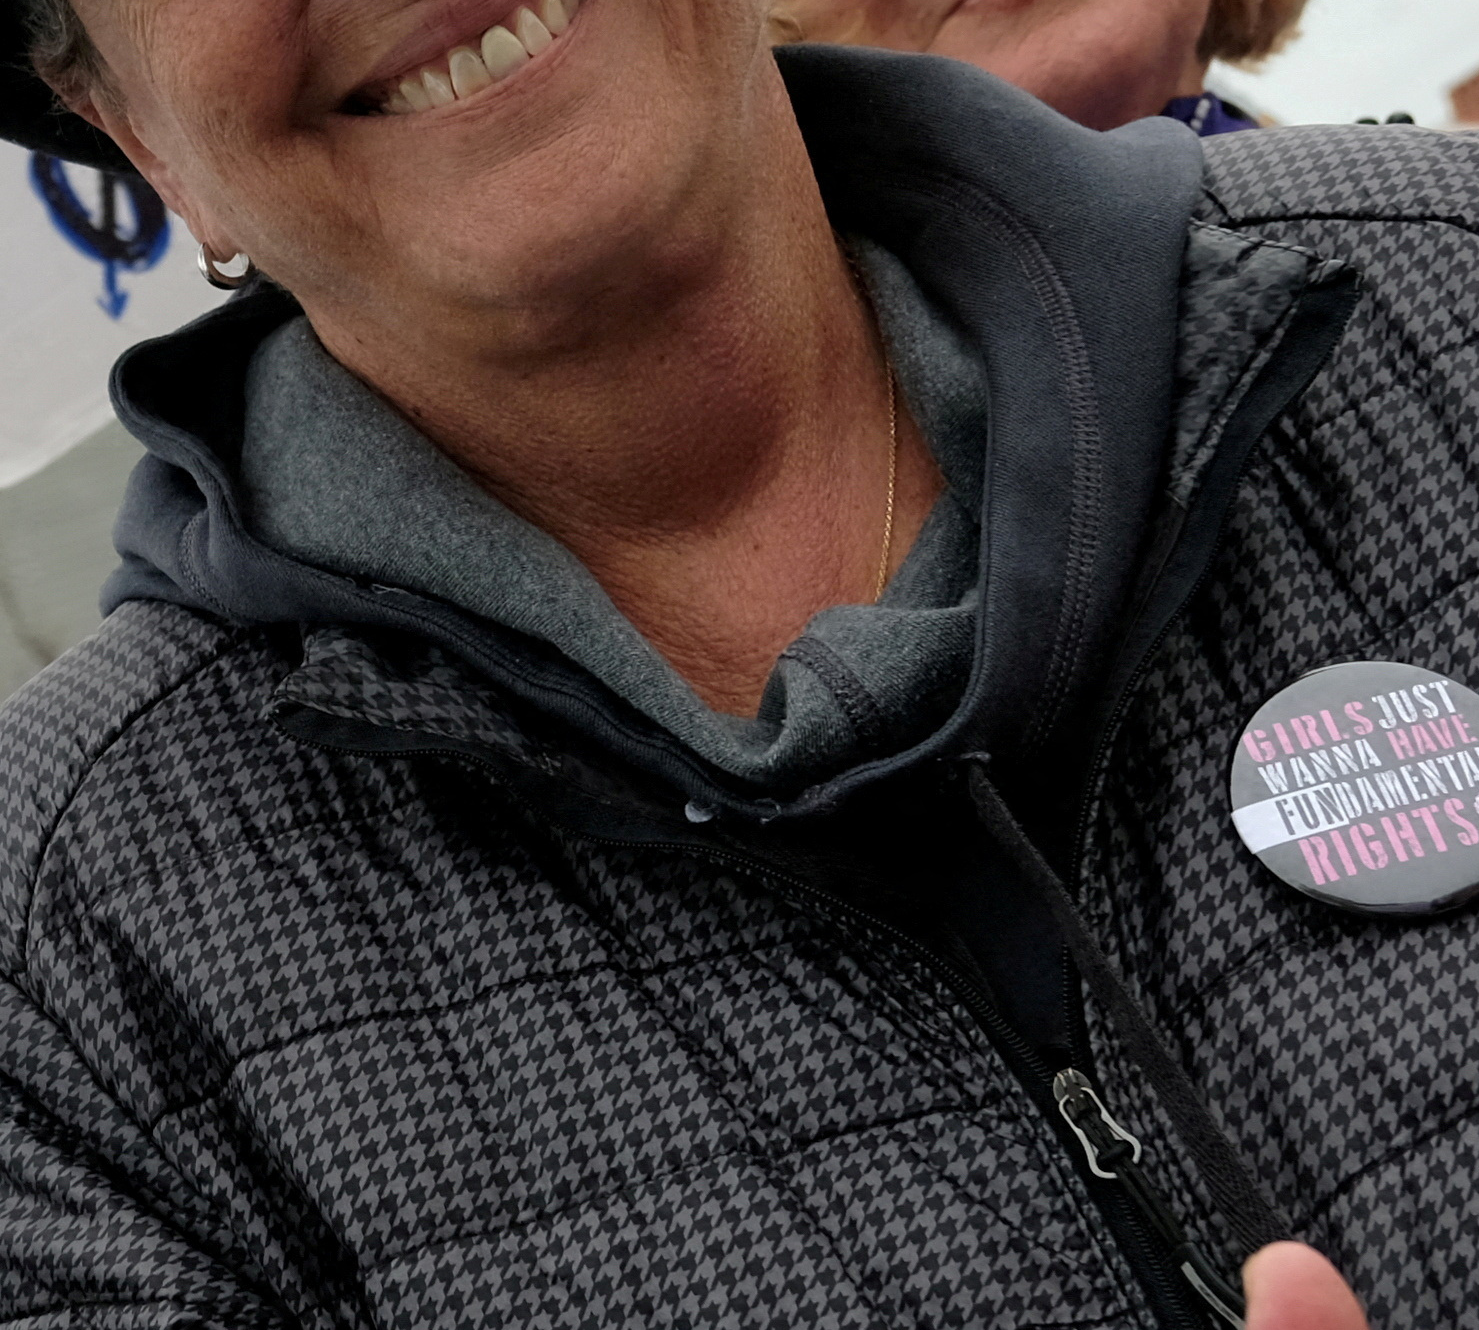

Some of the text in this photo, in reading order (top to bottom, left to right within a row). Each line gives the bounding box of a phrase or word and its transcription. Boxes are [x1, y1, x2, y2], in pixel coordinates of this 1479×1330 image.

[1243, 680, 1456, 763] GIRLS JUST
[1257, 714, 1479, 795] WANNA HAVE
[1298, 798, 1479, 885] RIGHTS
